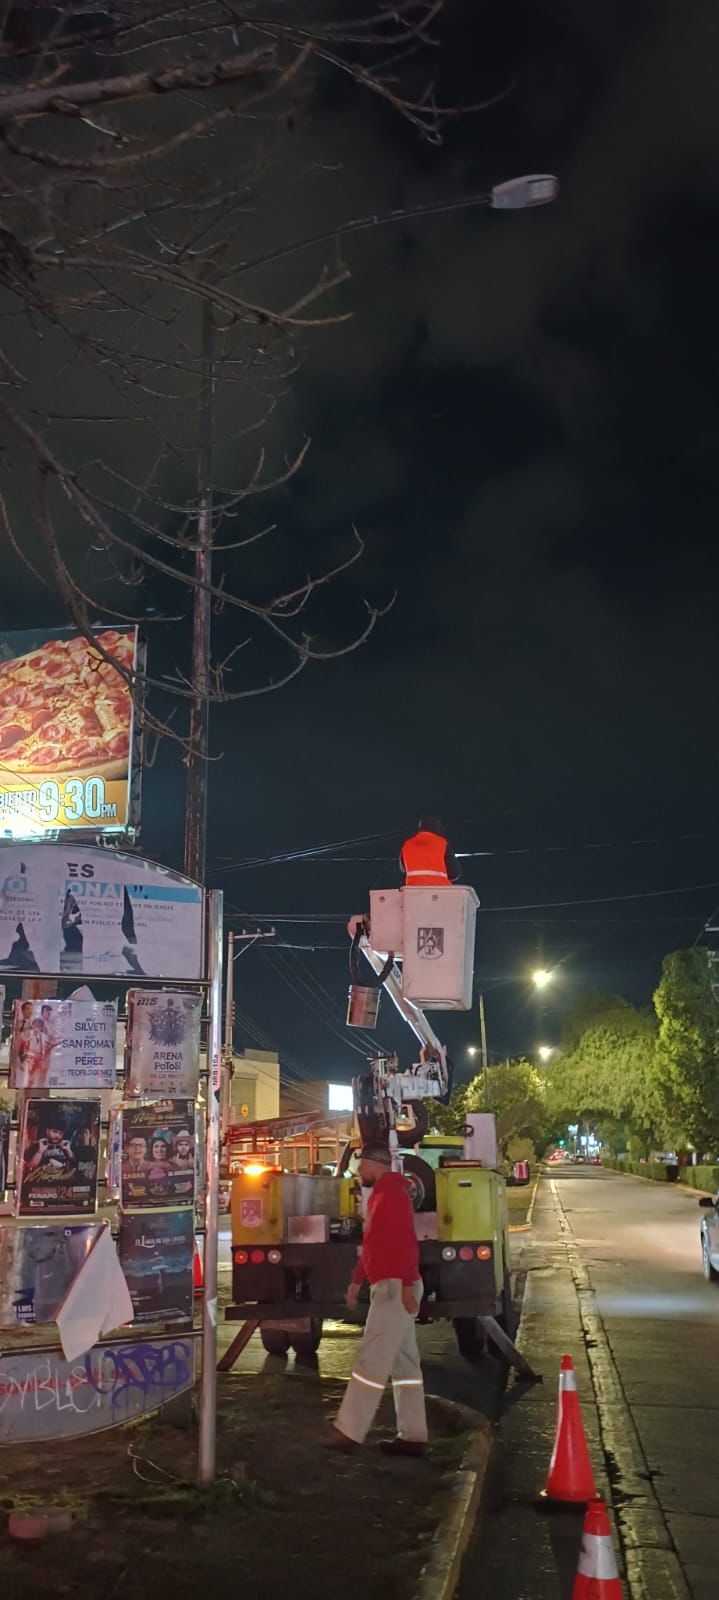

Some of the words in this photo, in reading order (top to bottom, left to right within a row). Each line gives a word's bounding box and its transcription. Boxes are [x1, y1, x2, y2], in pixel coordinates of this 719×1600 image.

[40, 776, 105, 822] 9:30
[101, 804, 117, 818] PM
[75, 1022, 106, 1031] SILVETI
[62, 1039, 83, 1048] SAN
[153, 1052, 183, 1061] ARENA
